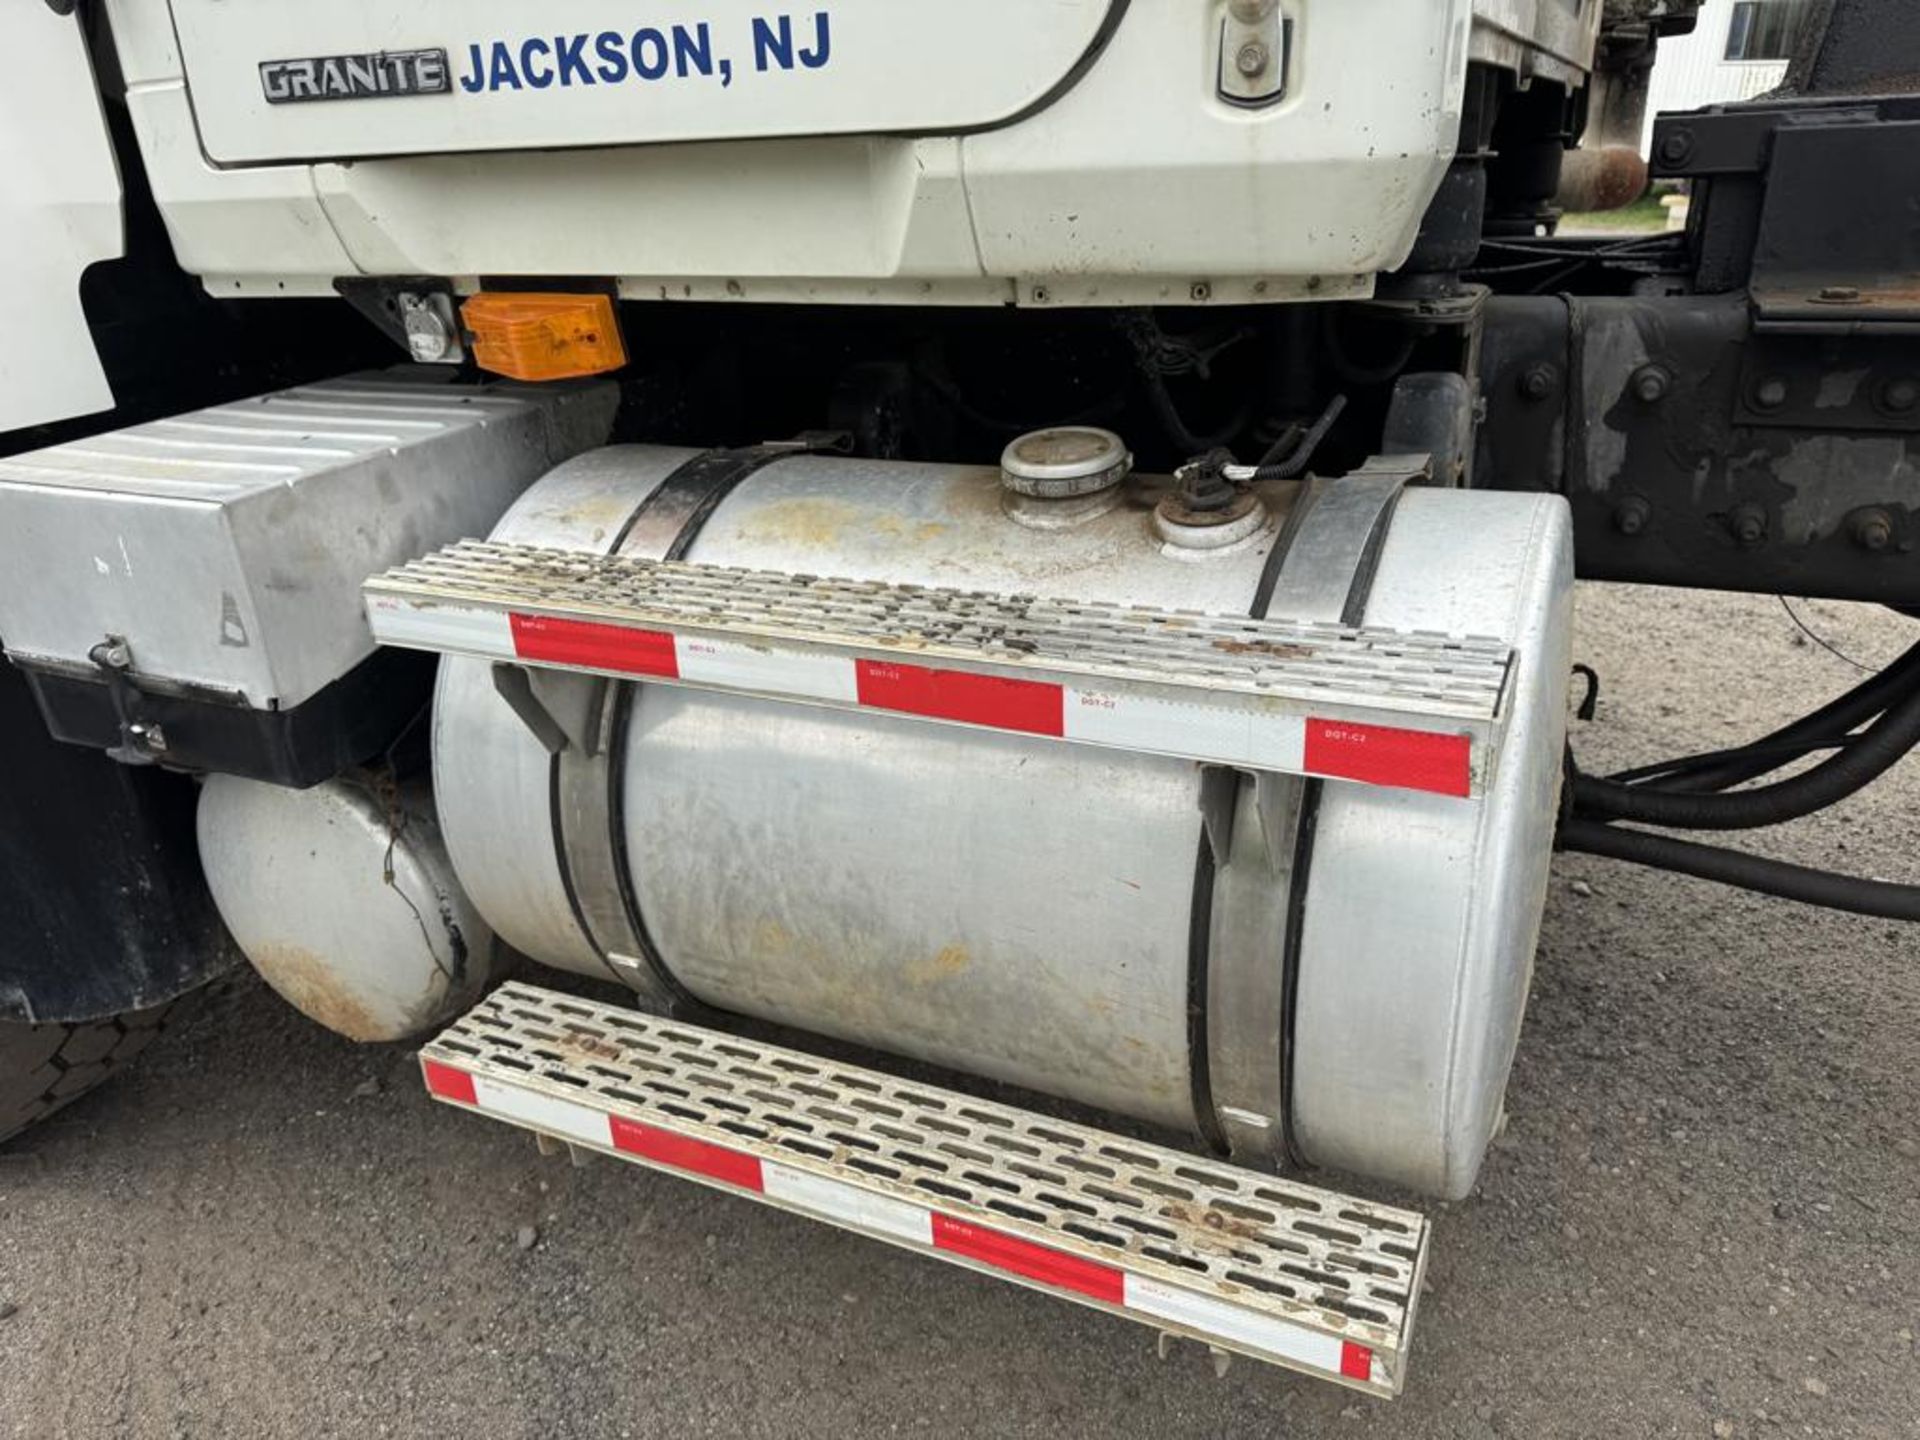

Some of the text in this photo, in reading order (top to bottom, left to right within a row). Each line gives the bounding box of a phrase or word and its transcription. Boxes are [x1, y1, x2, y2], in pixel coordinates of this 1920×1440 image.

[460, 12, 830, 93] JACKSON, NJ
[1324, 729, 1366, 743] DOT-C2
